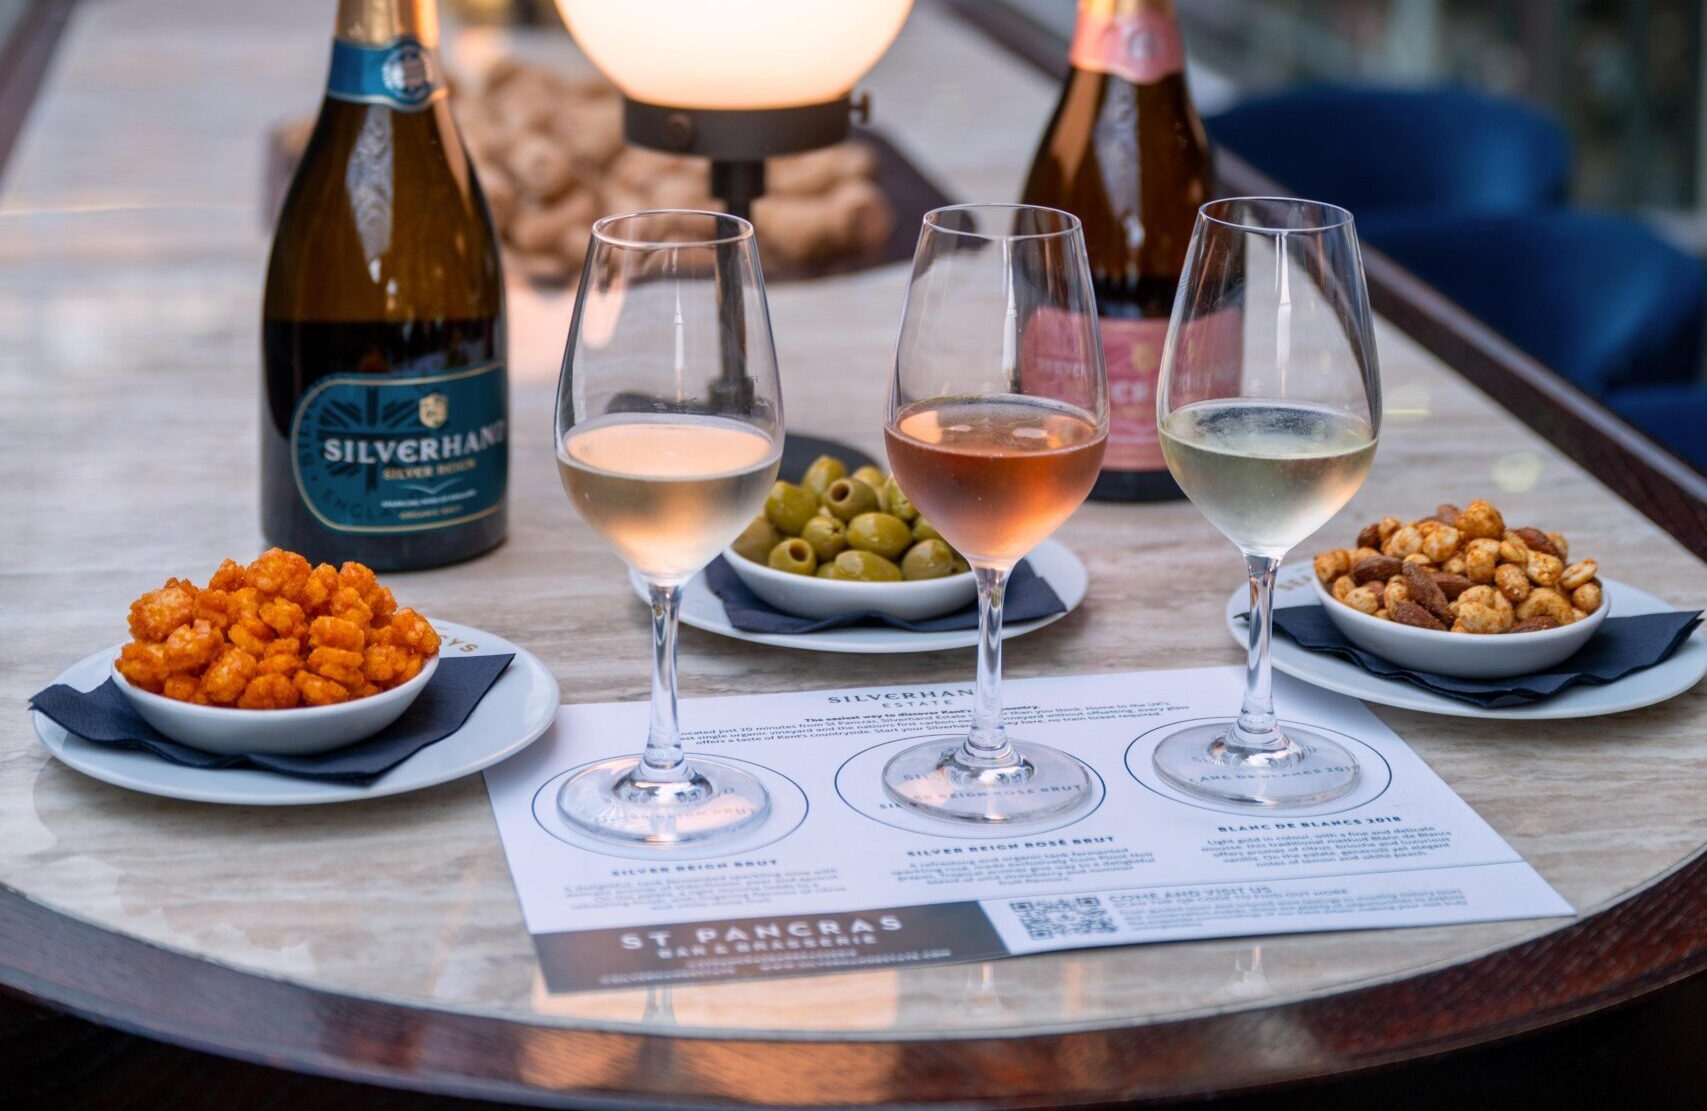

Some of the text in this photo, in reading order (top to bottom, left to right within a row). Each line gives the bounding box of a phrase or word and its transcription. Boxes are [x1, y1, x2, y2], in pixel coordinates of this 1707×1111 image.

[828, 689, 975, 704] SILVERHAN
[882, 700, 953, 709] ESTATE
[1217, 824, 1271, 833] BLANC
[1301, 819, 1362, 829] BLANCS
[1367, 816, 1402, 825] 2018
[907, 847, 963, 857] SILVER
[1072, 836, 1115, 845] BRUT
[611, 866, 670, 877] SILVER
[733, 858, 778, 868] BRUT
[1248, 886, 1272, 894] US
[619, 915, 903, 950] ST PANCRAS
[656, 944, 706, 960] BAR
[738, 933, 879, 954] BRASSERIE
